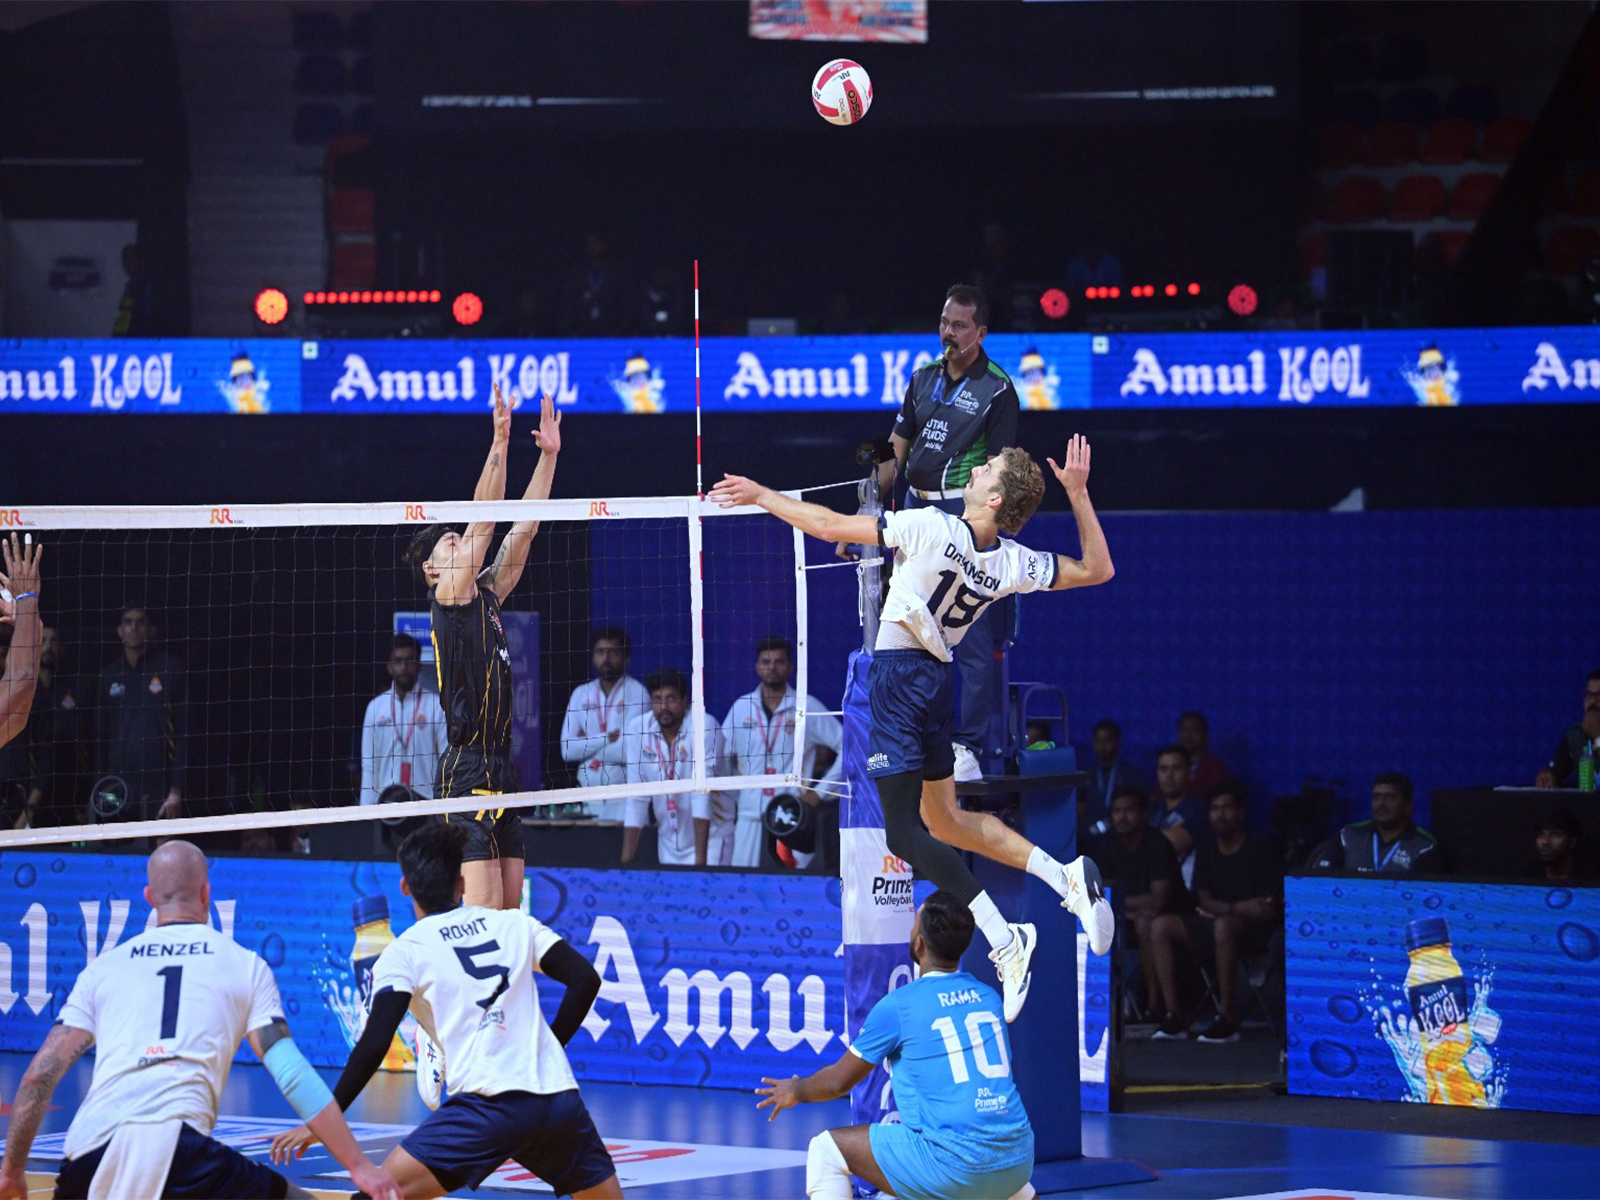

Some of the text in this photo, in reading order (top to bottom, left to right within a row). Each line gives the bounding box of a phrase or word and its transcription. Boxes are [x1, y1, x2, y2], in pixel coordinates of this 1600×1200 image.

[90, 353, 181, 409] KOOL
[331, 352, 578, 409] Amul KOOL
[724, 352, 870, 400] Amul
[1120, 345, 1370, 404] Amul KOOL
[130, 942, 214, 958] MENZEL
[439, 917, 487, 942] ROHIT
[156, 965, 183, 1039] 1
[452, 939, 510, 1010] 5
[570, 915, 850, 1055] Amu
[937, 989, 982, 1007] RAMA
[1420, 984, 1448, 1009] Amul
[1418, 992, 1465, 1035] KOOL
[931, 1010, 1009, 1084] 10
